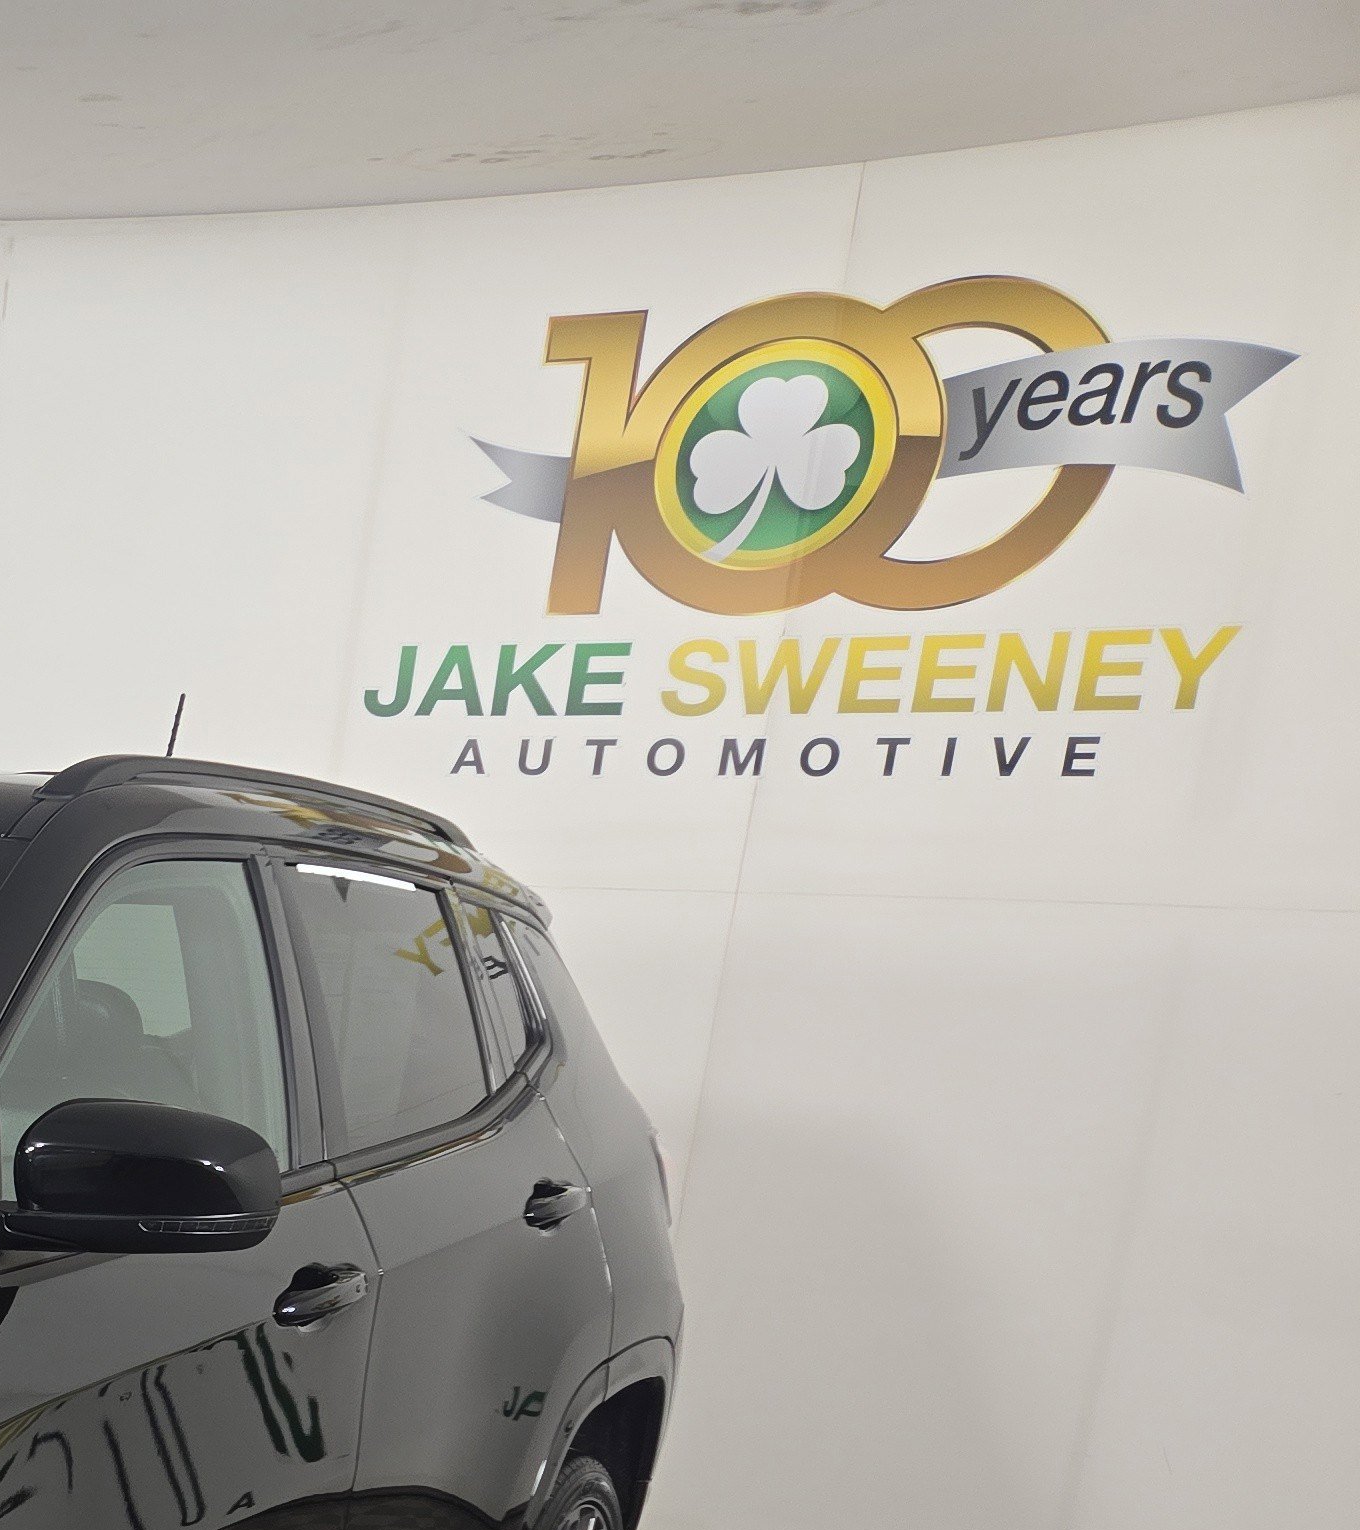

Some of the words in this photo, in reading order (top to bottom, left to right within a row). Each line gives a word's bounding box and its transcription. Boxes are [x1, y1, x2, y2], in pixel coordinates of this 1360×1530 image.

[957, 356, 1213, 462] years
[363, 641, 634, 718] JAKE
[660, 624, 1243, 717] SWEENEY
[448, 735, 1103, 779] AUTOMOTIVE
